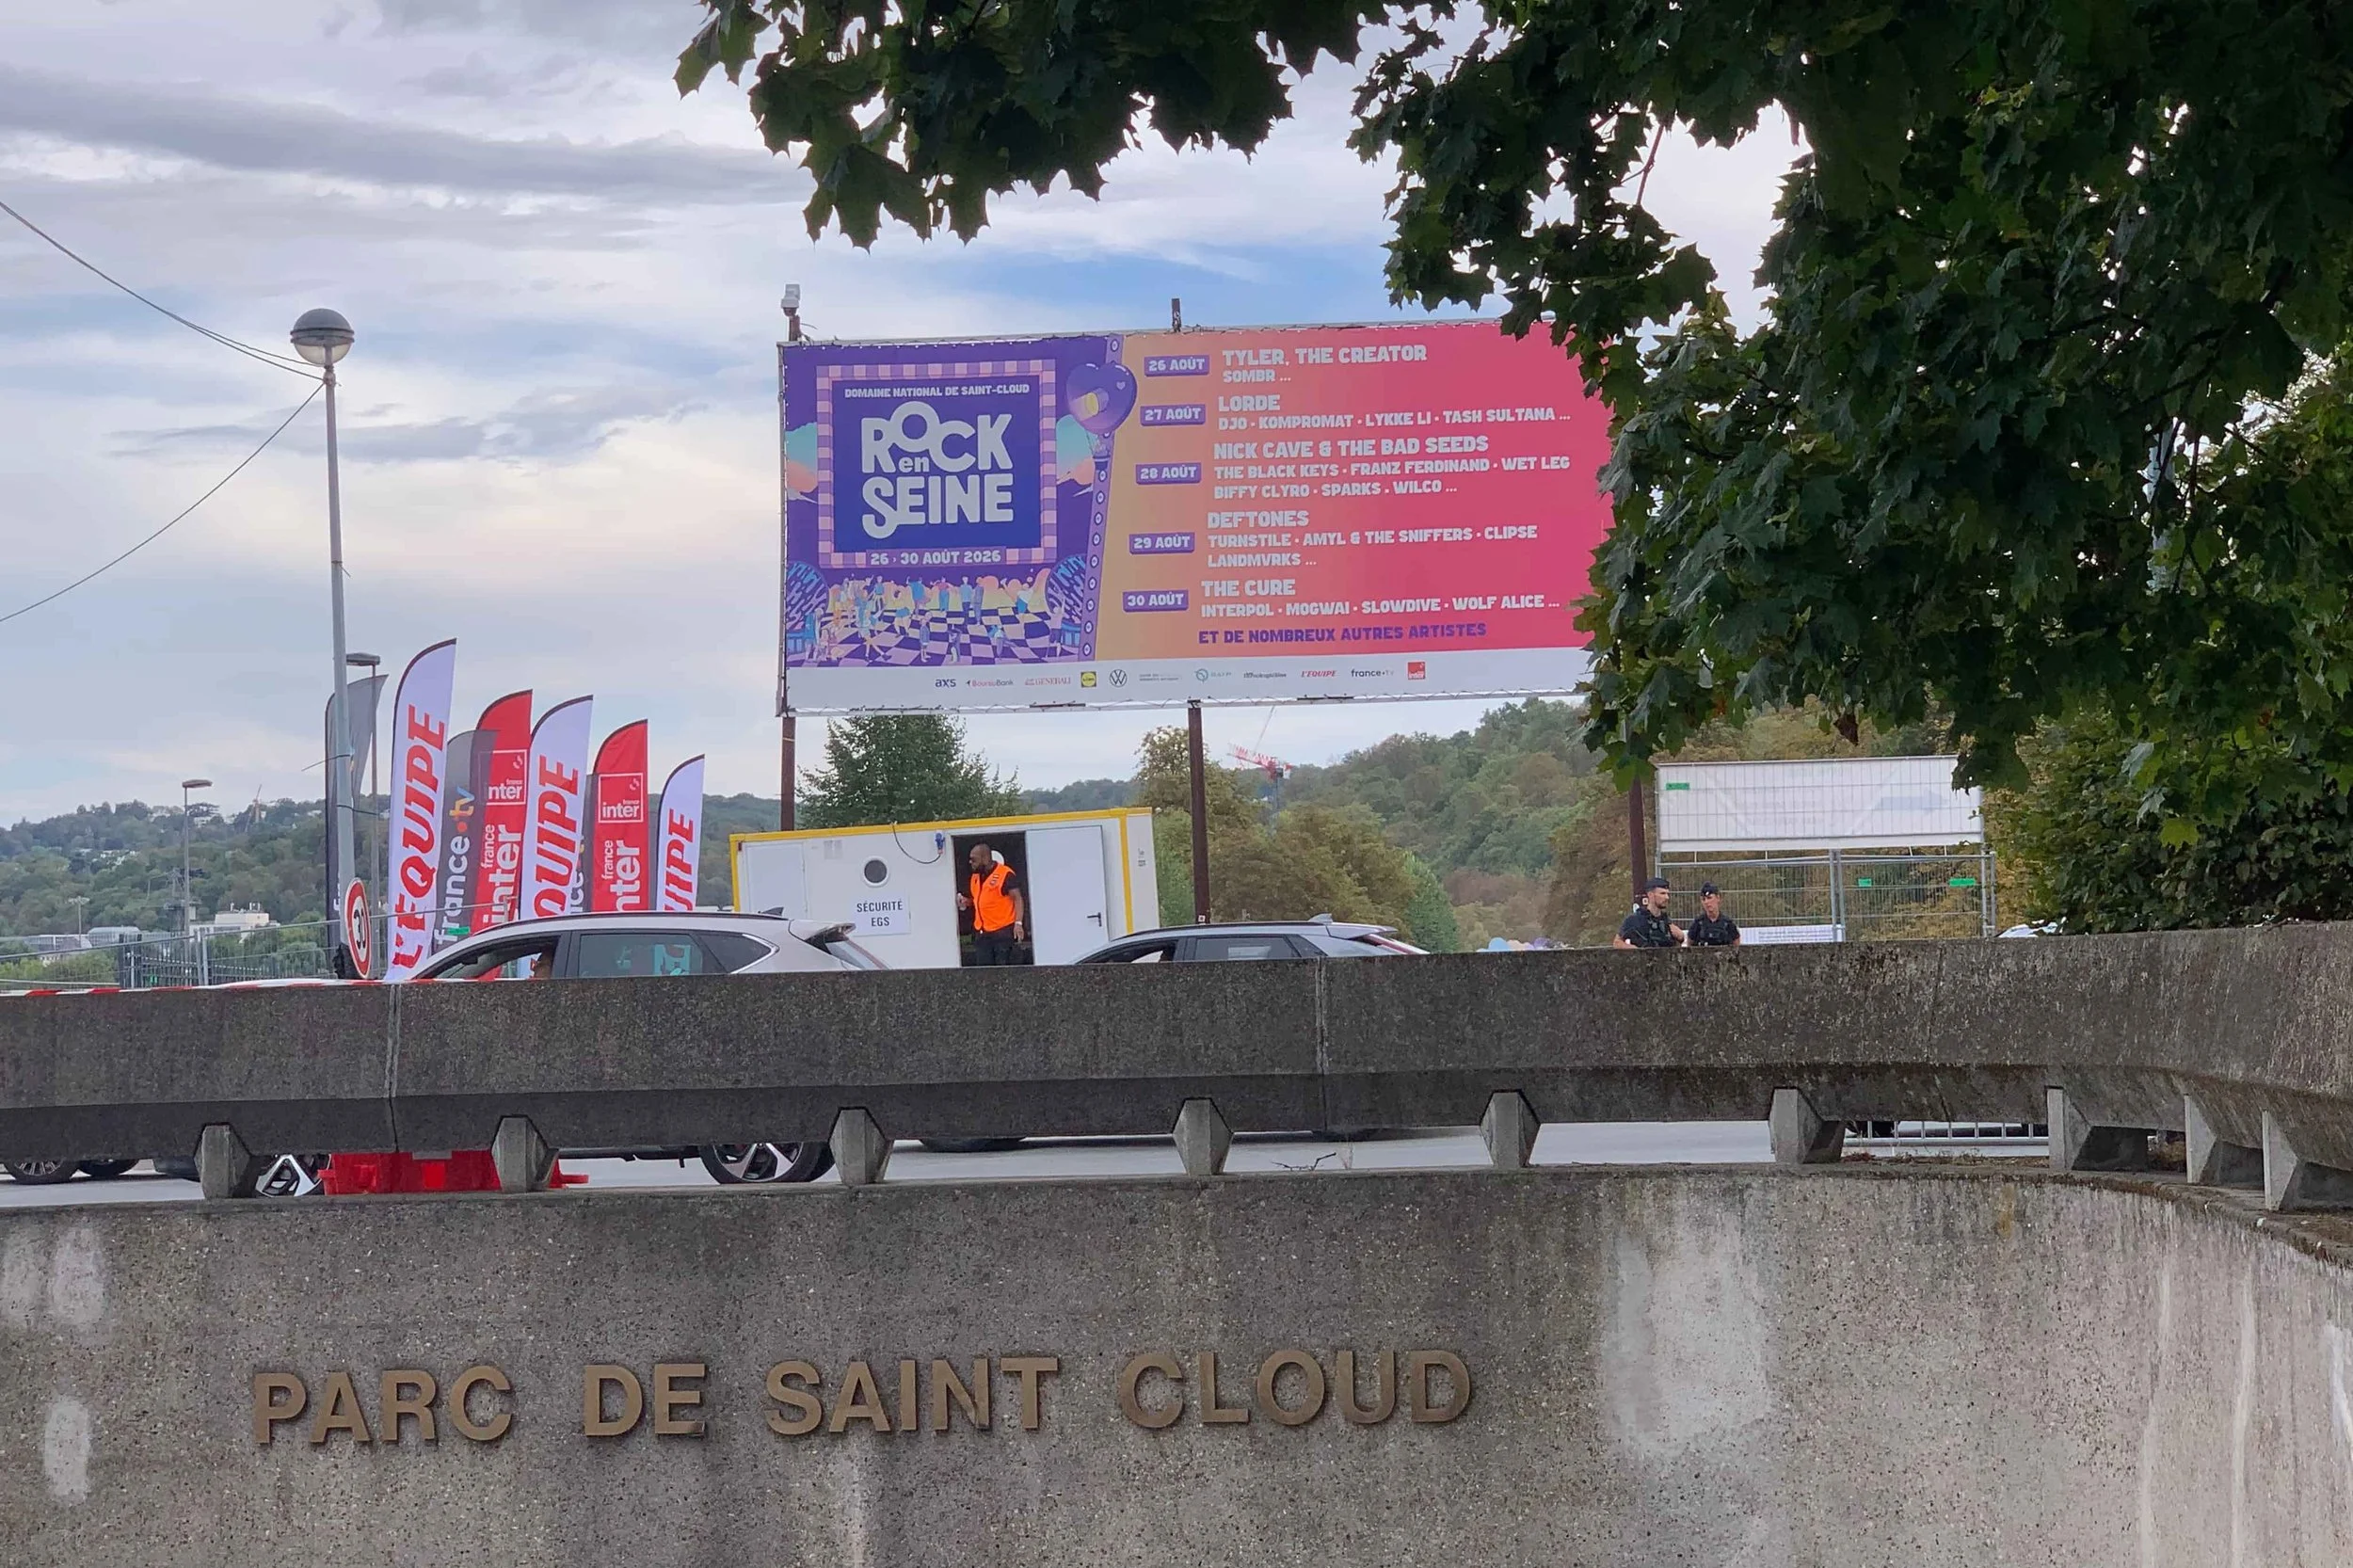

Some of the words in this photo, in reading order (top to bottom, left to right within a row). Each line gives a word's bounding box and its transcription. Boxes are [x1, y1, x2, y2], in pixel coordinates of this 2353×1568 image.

[1148, 360, 1165, 372] 26
[1169, 356, 1205, 371] AOÛT
[1223, 349, 1289, 368] TYLER,
[1295, 347, 1334, 365] THE
[1338, 344, 1427, 363] CREATOR
[1223, 369, 1275, 384] SOMBR
[844, 388, 891, 398] DOMAINE
[893, 387, 942, 397] NATIONAL
[945, 386, 959, 396] DE
[961, 384, 1030, 395] SAINT-CLOUD
[1218, 394, 1281, 412] LORDE
[1144, 408, 1161, 421] 27
[1166, 405, 1202, 420] AOÛT
[1219, 417, 1247, 430] DJO
[1258, 414, 1353, 429] KOMPROMAT
[1366, 412, 1414, 427] LYKKE
[1417, 411, 1431, 424] LI
[1443, 409, 1482, 424] TASH
[1486, 408, 1555, 423] SULTANA
[861, 401, 1014, 473] ROCK
[1214, 442, 1257, 460] NICK
[1262, 440, 1314, 458] CAVE
[1319, 440, 1332, 457] &
[1337, 440, 1376, 456] THE
[1381, 438, 1420, 456] BAD
[1425, 436, 1489, 454] SEEDS
[898, 456, 930, 472] en
[1140, 468, 1158, 480] 28
[1161, 464, 1197, 478] AOÛT
[1214, 466, 1243, 480] THE
[1248, 465, 1296, 479] BLACK
[1300, 463, 1339, 477] KEYS
[1351, 462, 1401, 476] FRANZ
[1404, 459, 1490, 474] FERDINAND
[1501, 457, 1537, 471] WET
[1541, 456, 1570, 470] LEG
[1214, 486, 1257, 500] BIFFY
[1261, 484, 1309, 498] CLYRO
[1321, 482, 1381, 497] SPARKS
[1393, 480, 1442, 495] WILCO
[862, 473, 1014, 539] SEINE
[1208, 510, 1309, 529] DEFTONES
[1133, 537, 1152, 550] 29
[1155, 534, 1191, 548] AOÛT
[1208, 534, 1291, 549] TURNSTILE
[1303, 533, 1346, 546] AMYL
[1351, 531, 1361, 544] &
[1365, 531, 1395, 544] THE
[1399, 527, 1473, 543] SNIFFERS
[1484, 525, 1538, 540] CLIPSE
[871, 552, 889, 565] 26
[900, 552, 919, 565] 30
[922, 549, 960, 564] AOÛT
[963, 550, 1001, 564] 2026
[1208, 552, 1301, 568] LANDMVRKS
[1201, 580, 1240, 597] THE
[1244, 579, 1296, 597] CURE
[1128, 595, 1145, 606] 30
[1149, 591, 1184, 606] AOÛT
[1201, 603, 1274, 618] INTERPOL
[1286, 601, 1350, 616] MOGWAI
[1361, 599, 1441, 615] SLOWDIVE
[1452, 597, 1497, 611] WOLF
[1501, 595, 1545, 609] ALICE
[1198, 631, 1219, 645] ET
[1224, 630, 1244, 644] DE
[1248, 628, 1336, 643] NOMBREUX
[1340, 626, 1403, 641] AUTRES
[1408, 623, 1487, 639] ARTISTES
[488, 786, 523, 801] nter
[602, 802, 640, 818] inter
[534, 755, 579, 918] QUIPE
[481, 824, 495, 869] france
[601, 840, 614, 880] france
[610, 840, 640, 911] nter
[856, 898, 904, 912] SÉCURITÉ
[871, 916, 890, 927] EGS
[252, 1365, 513, 1445] PARC
[583, 1363, 706, 1438] DE
[763, 1356, 1059, 1436] SAINT
[1117, 1348, 1472, 1430] CLOUD
